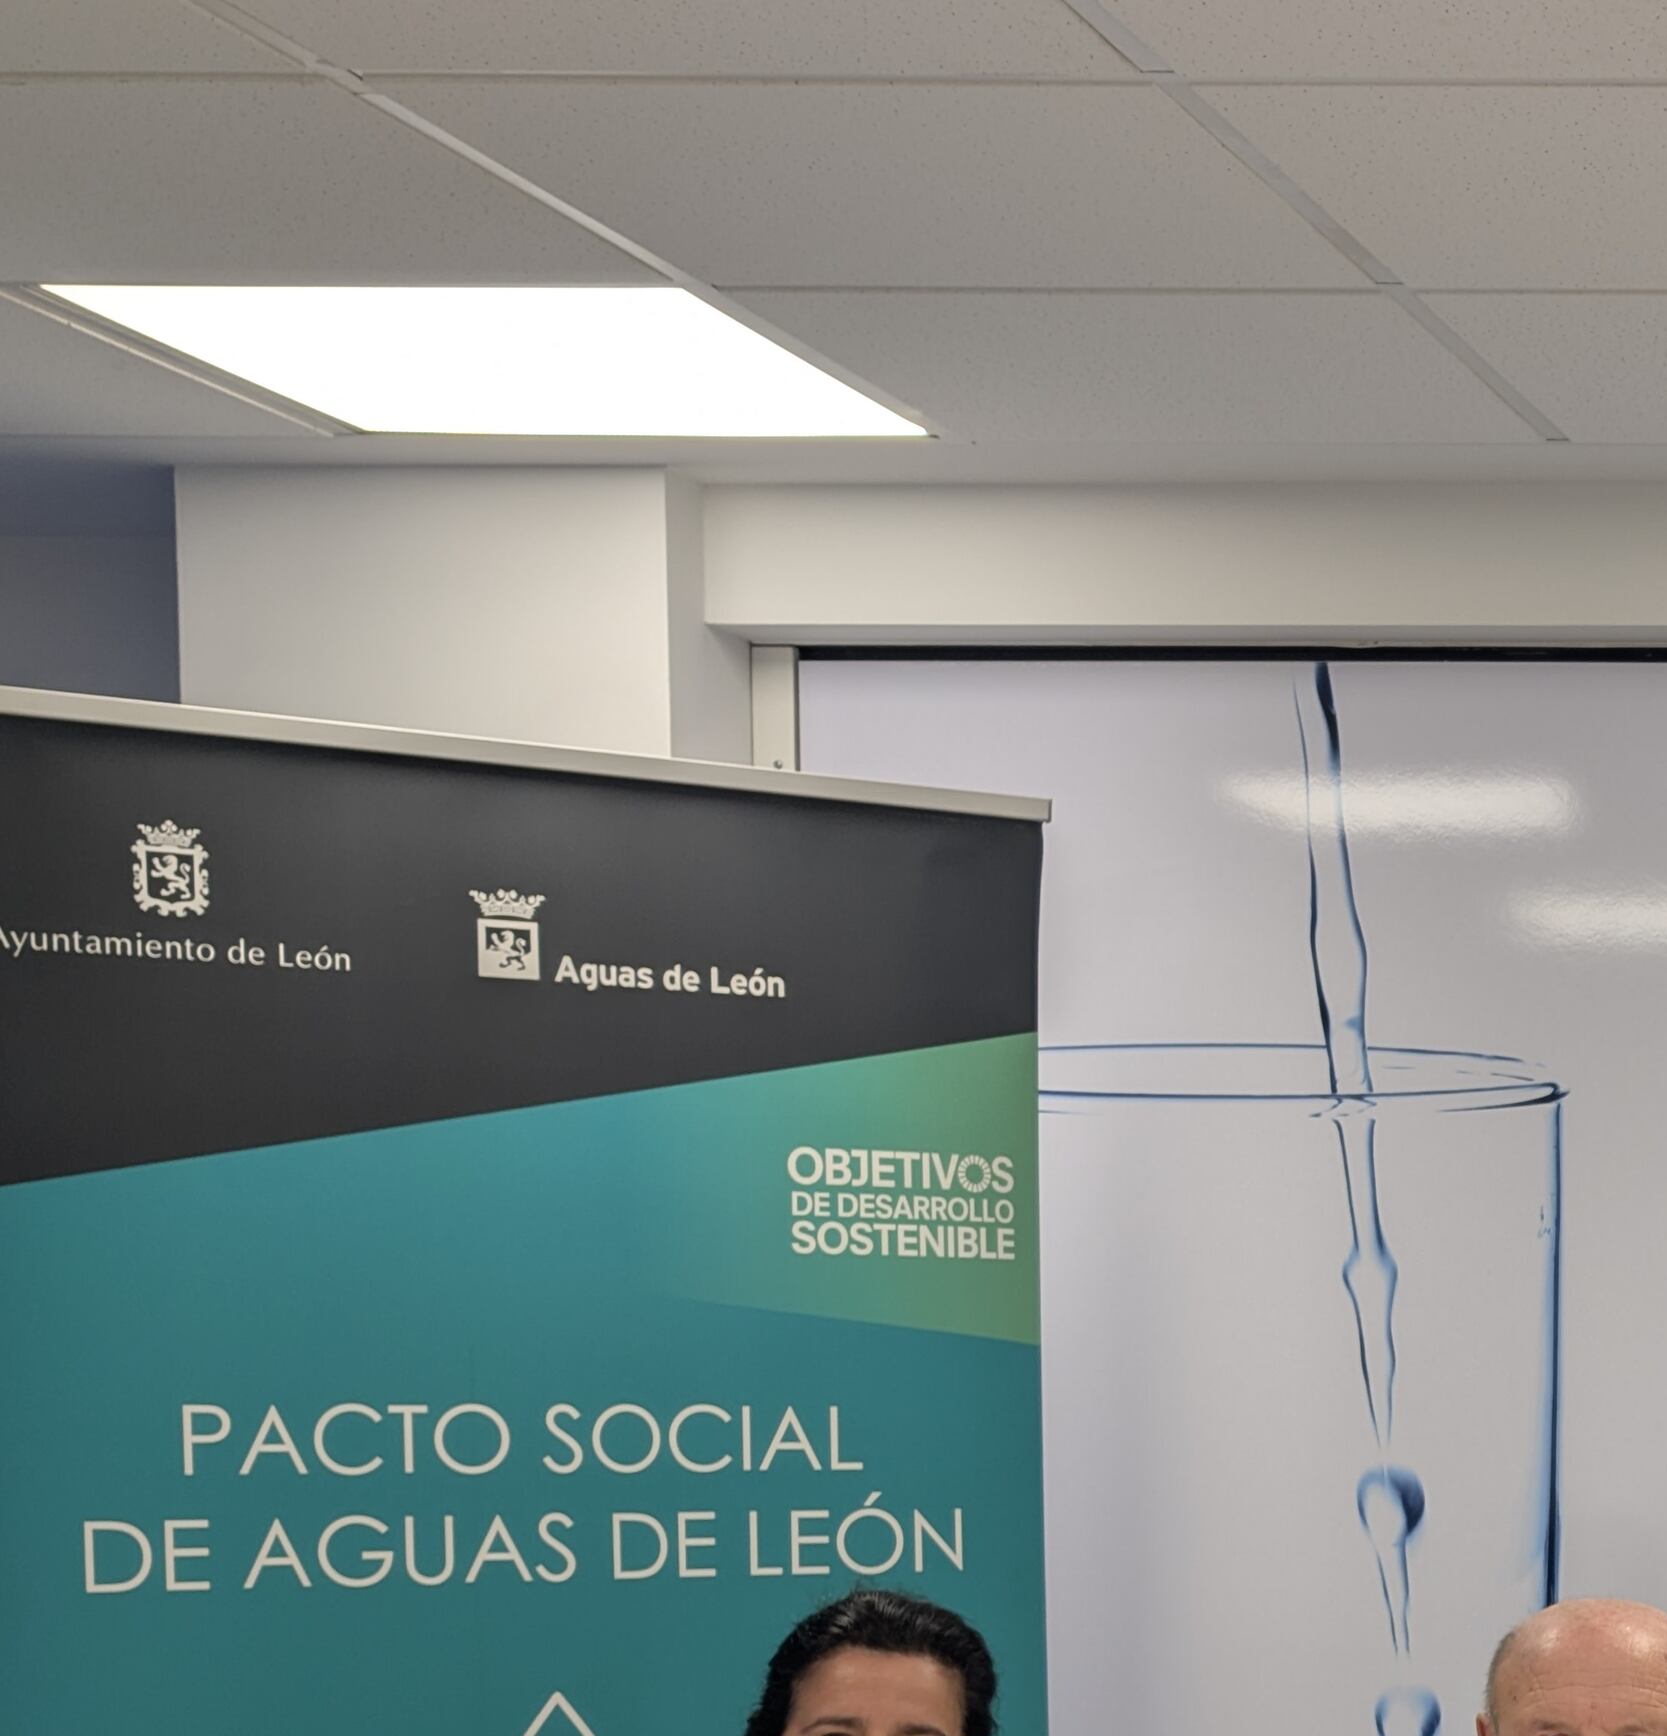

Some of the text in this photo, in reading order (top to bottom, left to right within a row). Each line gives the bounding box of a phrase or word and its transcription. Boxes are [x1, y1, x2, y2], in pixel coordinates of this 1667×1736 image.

[227, 938, 266, 966] de
[278, 943, 352, 972] León
[554, 955, 786, 998] Aguas de León
[787, 1146, 1015, 1194] OBJETIVOS
[791, 1191, 1014, 1225] DE DESARROLLO
[791, 1220, 1016, 1261] SOSTENIBLE
[181, 1403, 863, 1477] PACTO SOCIAL
[83, 1490, 964, 1594] DE AGUAS DE LEÓN
